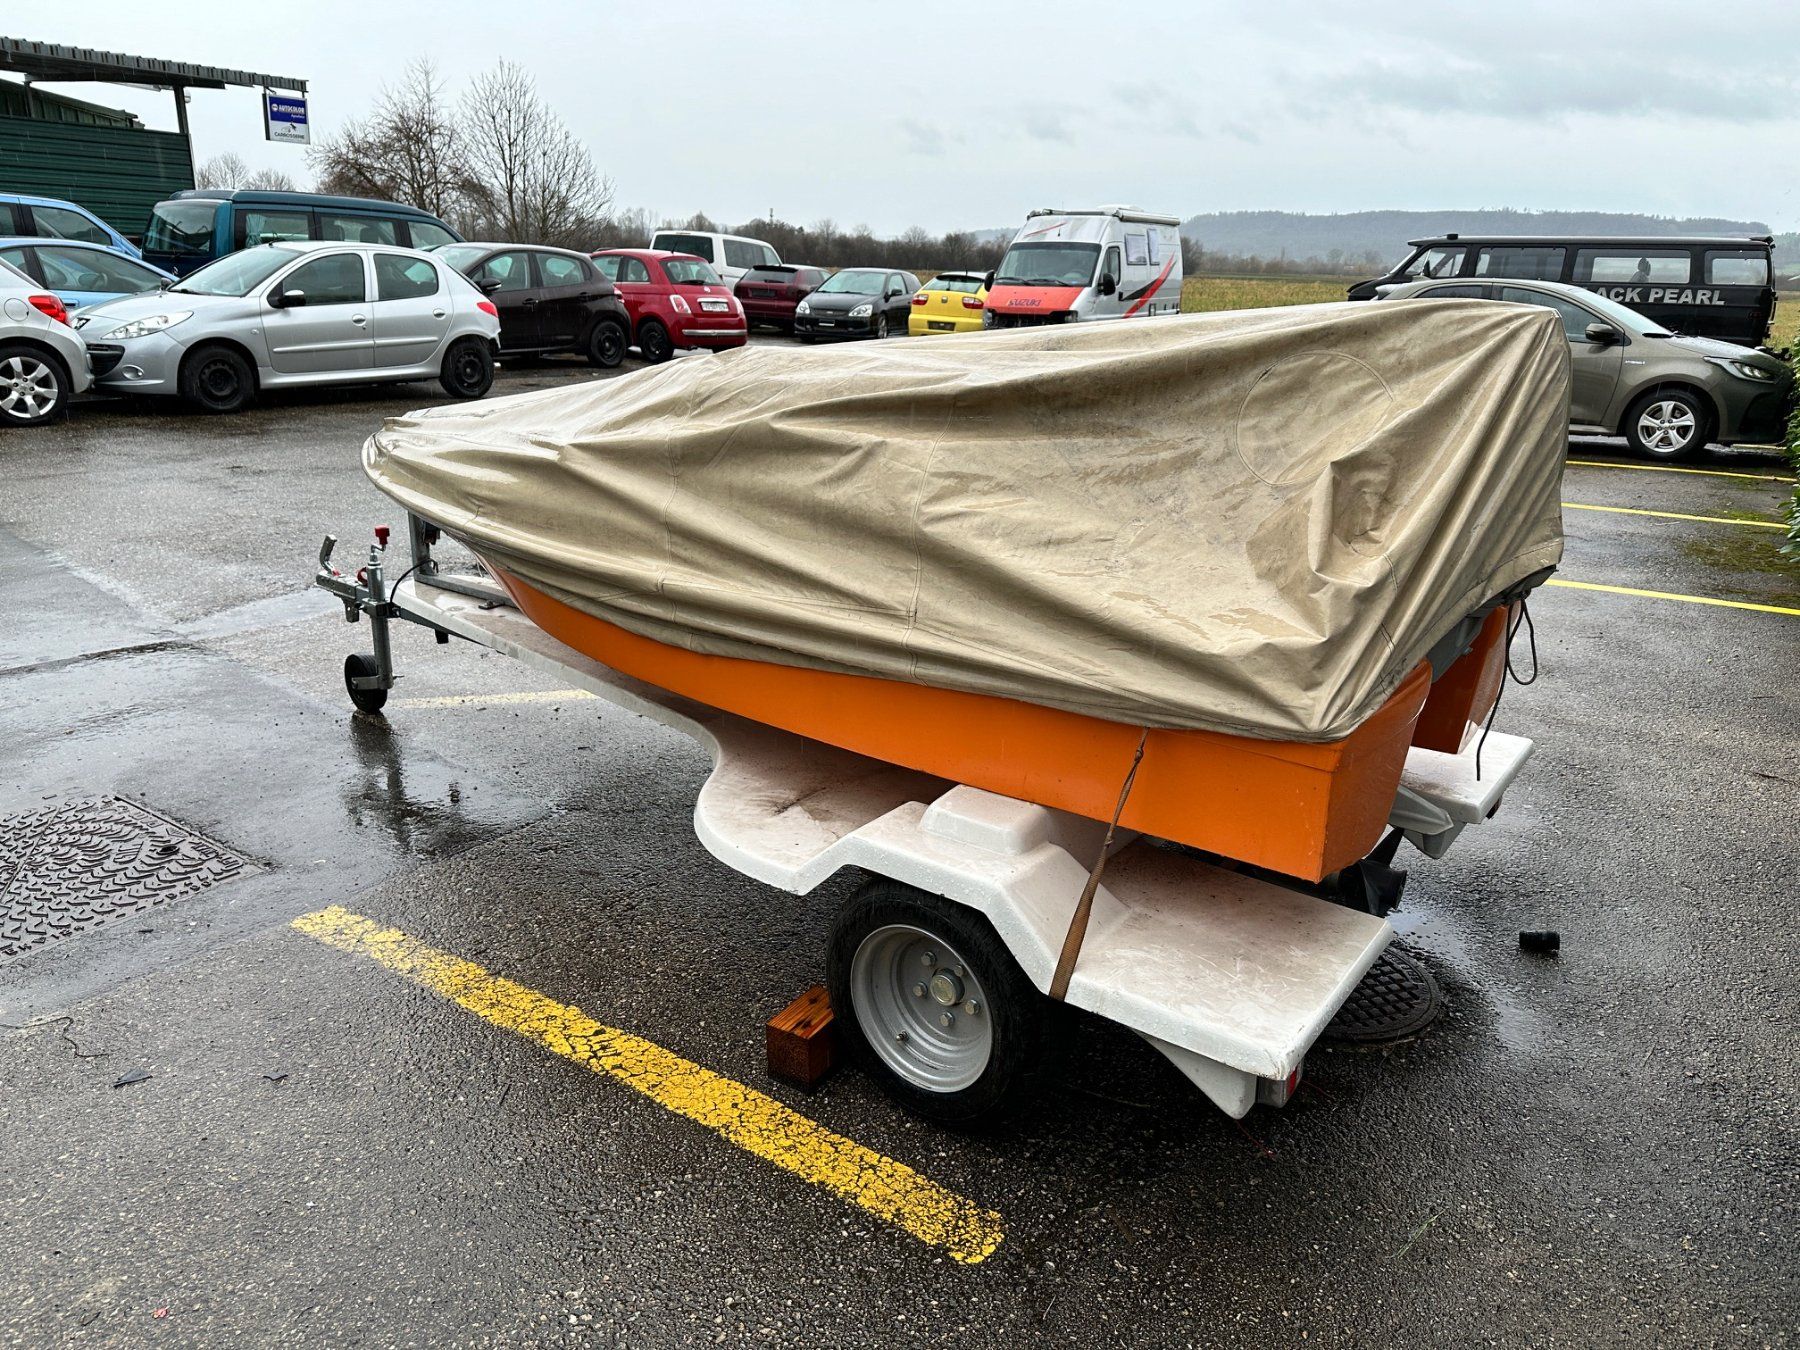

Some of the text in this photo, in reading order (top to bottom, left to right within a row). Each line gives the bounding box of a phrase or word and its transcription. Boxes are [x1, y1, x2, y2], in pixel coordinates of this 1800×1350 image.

[1009, 298, 1041, 307] SUZUKI
[1594, 286, 1725, 306] ACK PEARL
